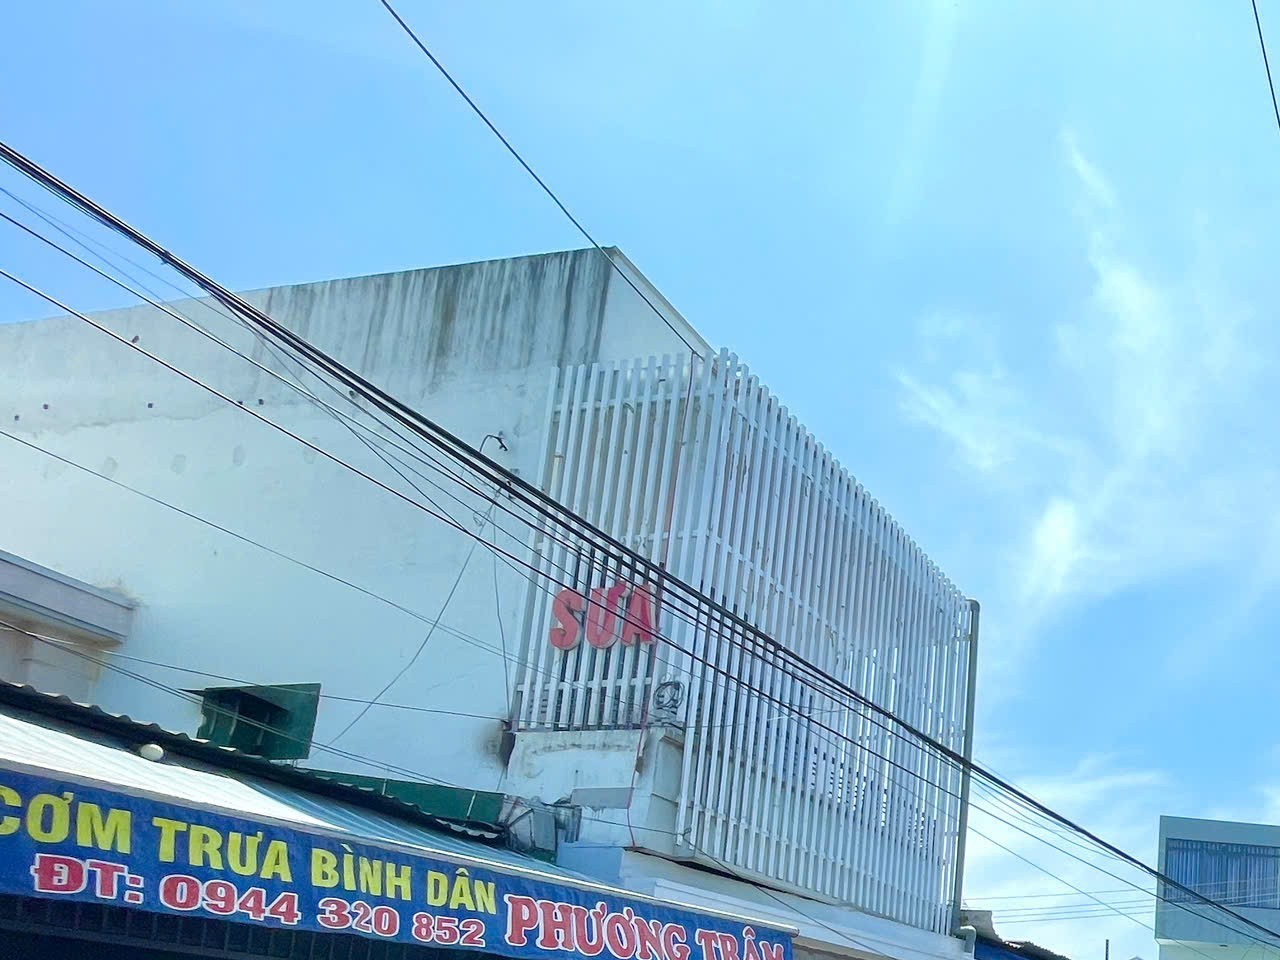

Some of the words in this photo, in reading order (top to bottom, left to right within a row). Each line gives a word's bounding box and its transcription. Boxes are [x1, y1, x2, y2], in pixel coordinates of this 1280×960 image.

[30, 852, 145, 905] ĐT:
[159, 874, 302, 926] 0944
[317, 897, 400, 938] 320
[412, 911, 487, 948] 852
[153, 817, 293, 884] TRƯA
[311, 843, 412, 901] BÌNH
[427, 868, 496, 915] DÂN
